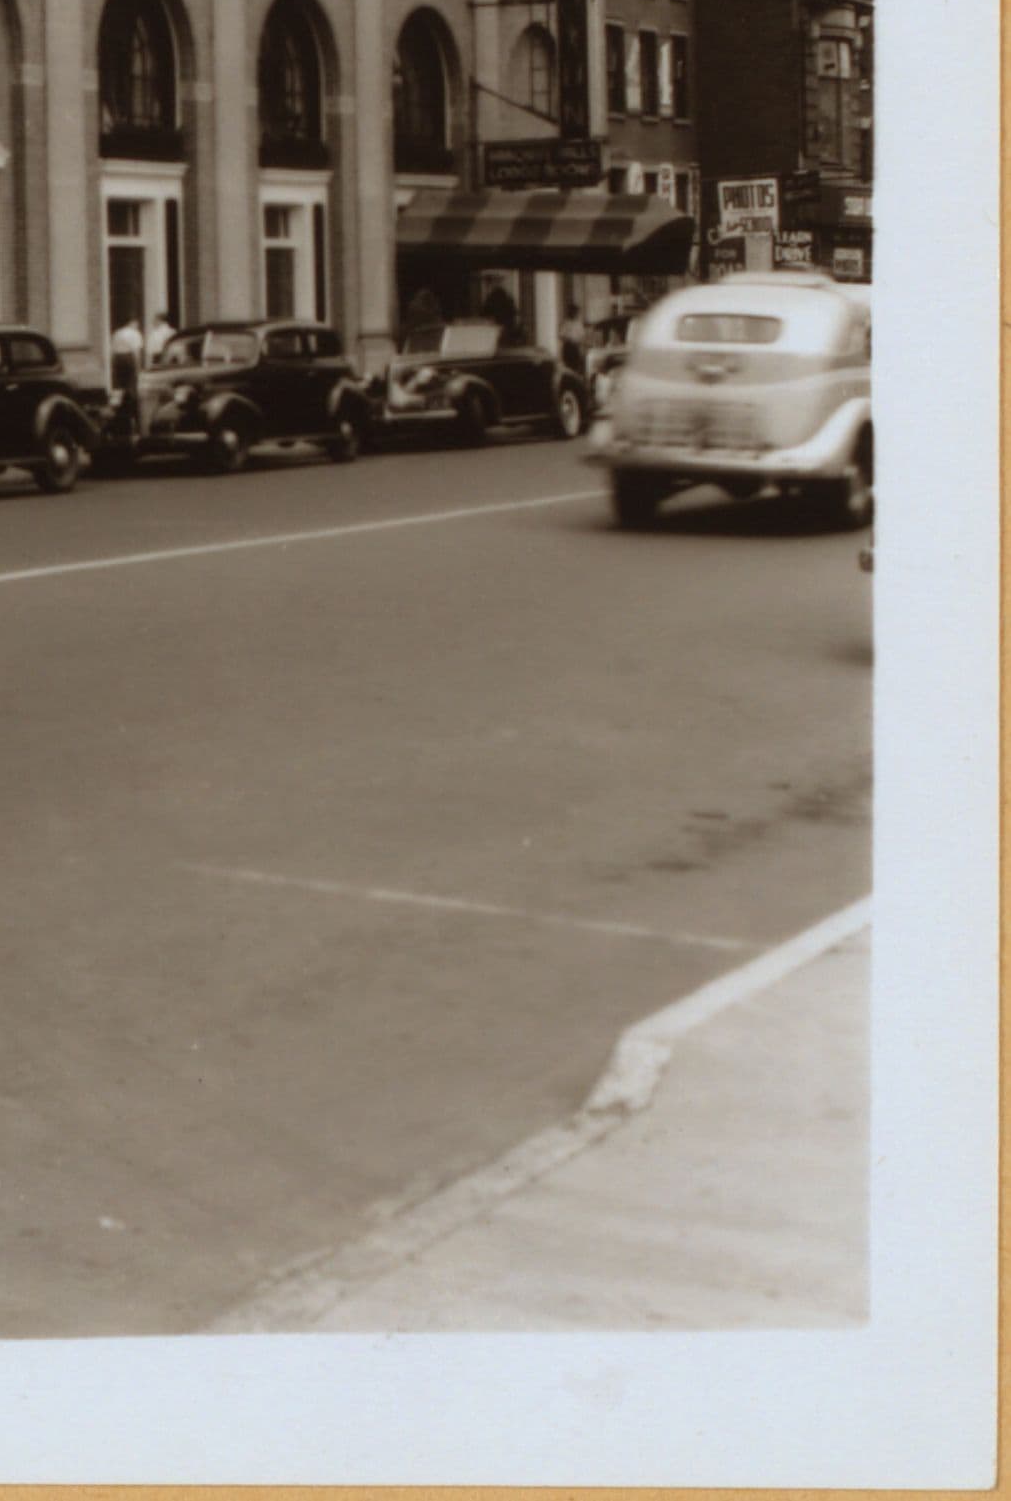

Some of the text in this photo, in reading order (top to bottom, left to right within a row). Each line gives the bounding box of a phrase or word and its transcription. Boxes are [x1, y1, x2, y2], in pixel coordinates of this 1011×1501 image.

[723, 184, 775, 210] PHOTOS
[775, 230, 813, 244] LEARN
[774, 245, 812, 262] DRIVE
